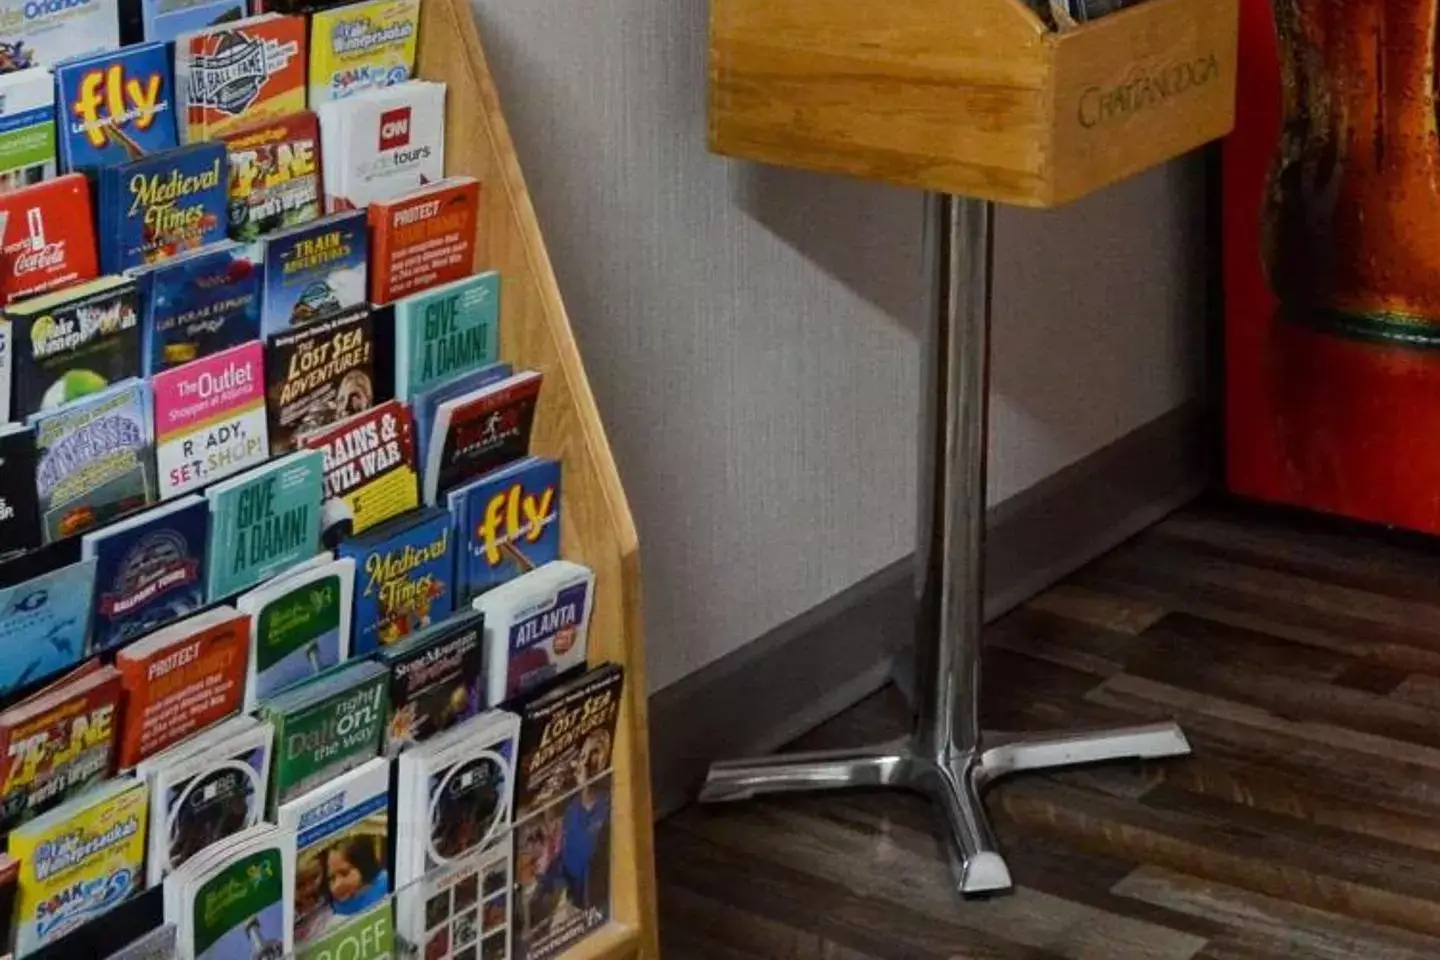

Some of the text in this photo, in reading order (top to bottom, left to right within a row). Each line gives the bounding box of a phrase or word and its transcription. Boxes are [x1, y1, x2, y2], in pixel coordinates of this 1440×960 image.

[72, 64, 162, 147] fly
[381, 114, 408, 137] CNN
[393, 144, 431, 165] tours
[128, 157, 220, 218] Medieval
[145, 201, 205, 239] Times
[393, 200, 441, 228] PROTECT
[295, 231, 340, 259] TRAIN
[425, 295, 460, 342] GIVE
[279, 343, 370, 404] ADVENTURE!
[287, 328, 362, 382] LOST SEA
[421, 322, 488, 384] A DAMN!
[199, 361, 253, 398] Outlet
[183, 420, 246, 459] RADY,
[323, 413, 398, 469] RAINS &
[361, 441, 401, 476] WAR
[237, 477, 276, 529] GIVE
[477, 484, 554, 565] fly
[233, 504, 308, 575] A DAMN!
[364, 527, 448, 597] Medieval
[379, 571, 433, 610] Times
[515, 604, 576, 648] ATLANTA
[148, 641, 200, 681] PROTECT
[540, 708, 581, 749] LOST
[581, 690, 611, 721] SEA
[335, 918, 385, 960] OFF
